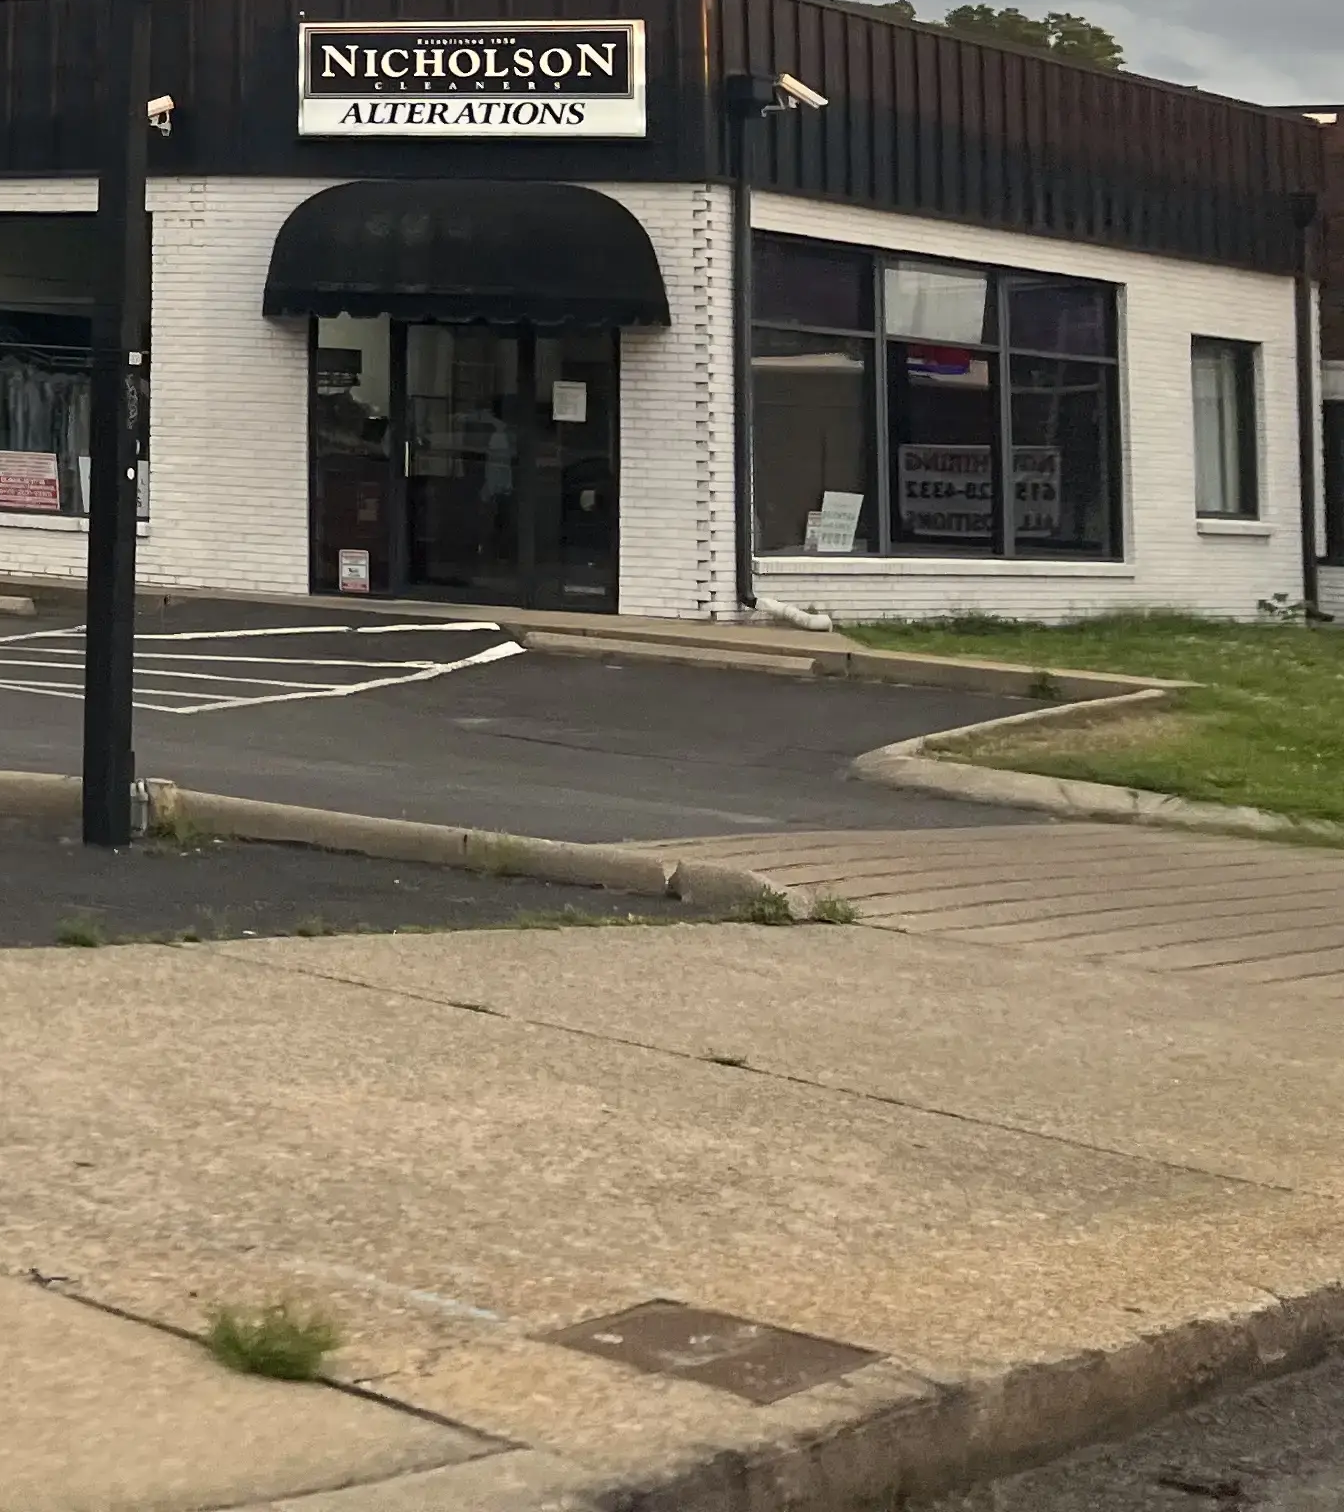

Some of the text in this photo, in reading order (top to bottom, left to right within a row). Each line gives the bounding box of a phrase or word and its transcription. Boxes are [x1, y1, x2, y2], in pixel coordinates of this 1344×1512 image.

[321, 43, 617, 78] NICHOLSON
[373, 81, 561, 91] CLEANERS
[339, 101, 586, 125] ALTERATIONS
